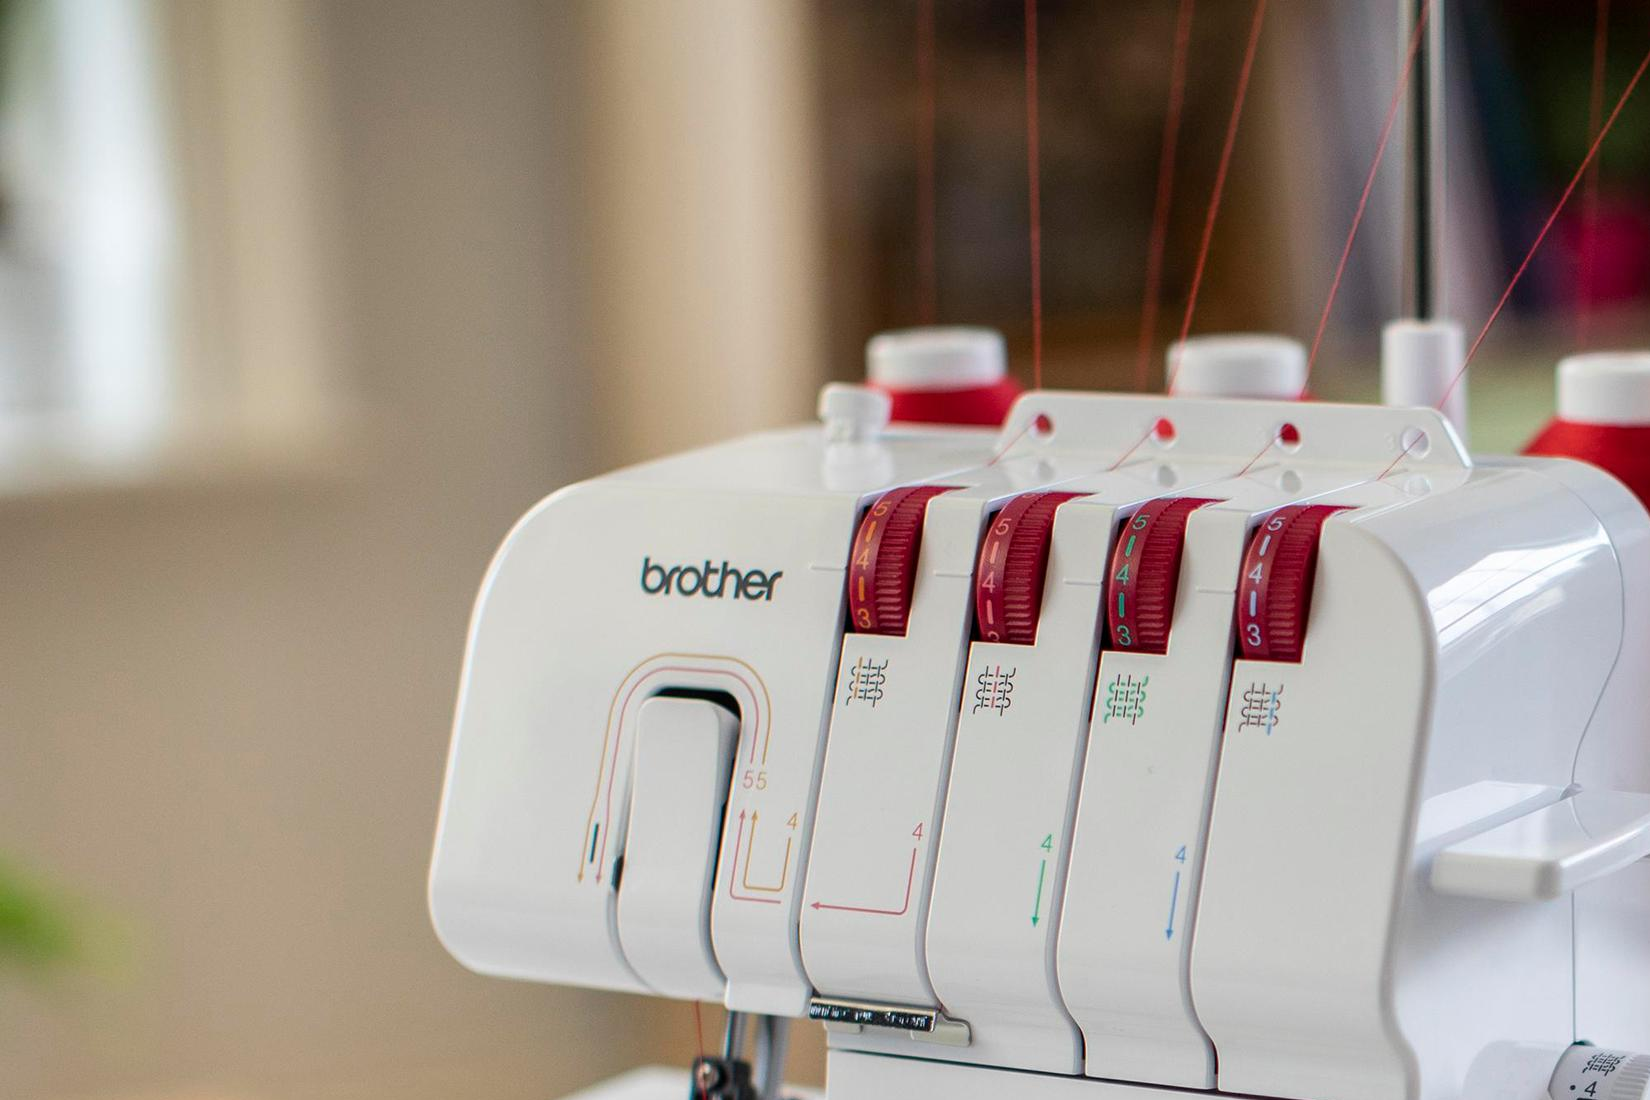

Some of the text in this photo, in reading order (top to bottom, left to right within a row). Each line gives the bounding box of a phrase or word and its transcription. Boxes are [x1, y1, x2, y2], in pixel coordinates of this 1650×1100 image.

[995, 518, 1012, 535] 5
[1132, 514, 1150, 530] 5
[1267, 517, 1286, 531] 5
[856, 548, 870, 570] 4
[641, 556, 784, 601] brother
[982, 573, 996, 593] 4
[1115, 564, 1129, 585] 4
[1249, 562, 1262, 584] 4
[857, 608, 871, 630] 3
[1117, 625, 1131, 646] 3
[1247, 623, 1261, 647] 3
[786, 812, 798, 831] 4
[911, 822, 923, 842] 4
[1040, 833, 1053, 853] 4
[1175, 844, 1186, 864] 4
[1584, 1081, 1598, 1097] 4
